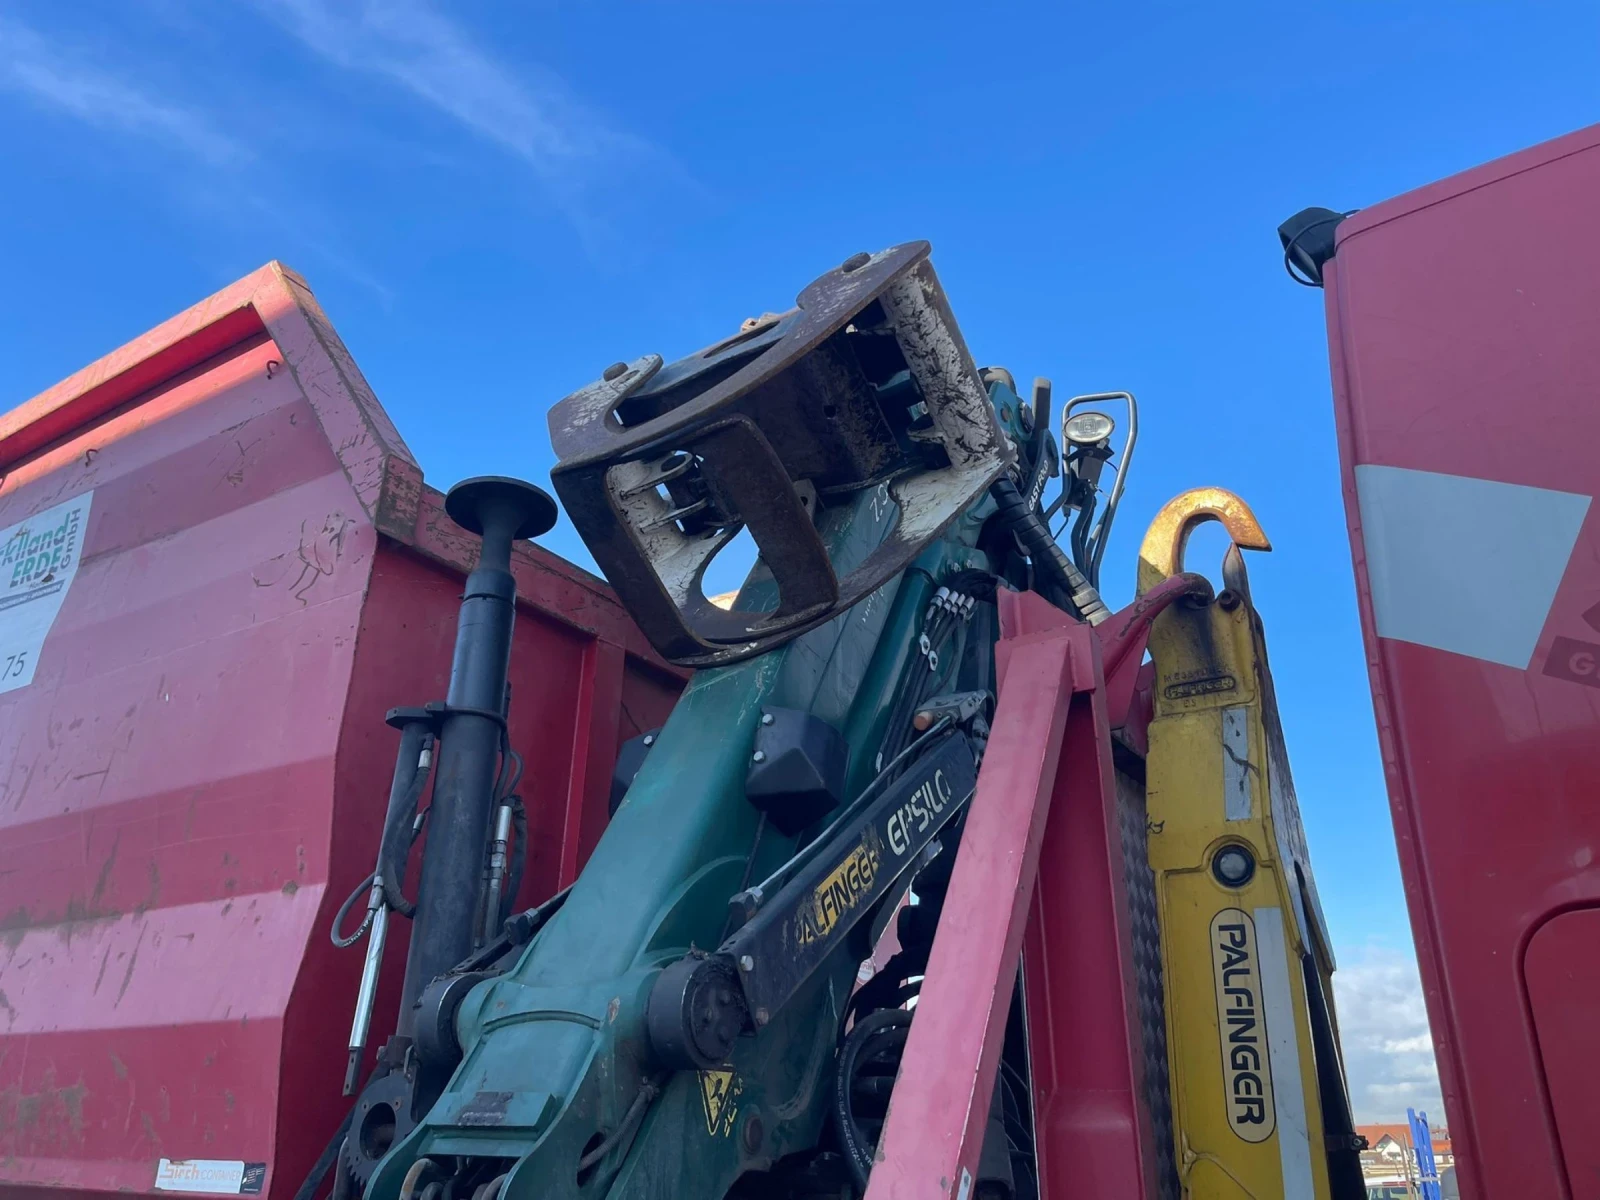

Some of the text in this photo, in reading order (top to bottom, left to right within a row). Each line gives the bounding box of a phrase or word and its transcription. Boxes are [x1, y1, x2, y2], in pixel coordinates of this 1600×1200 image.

[60, 507, 82, 570] GmbH
[10, 545, 64, 588] ERDE
[2, 651, 27, 681] 75
[1568, 651, 1600, 682] G
[1218, 923, 1266, 1125] PALFINGER
